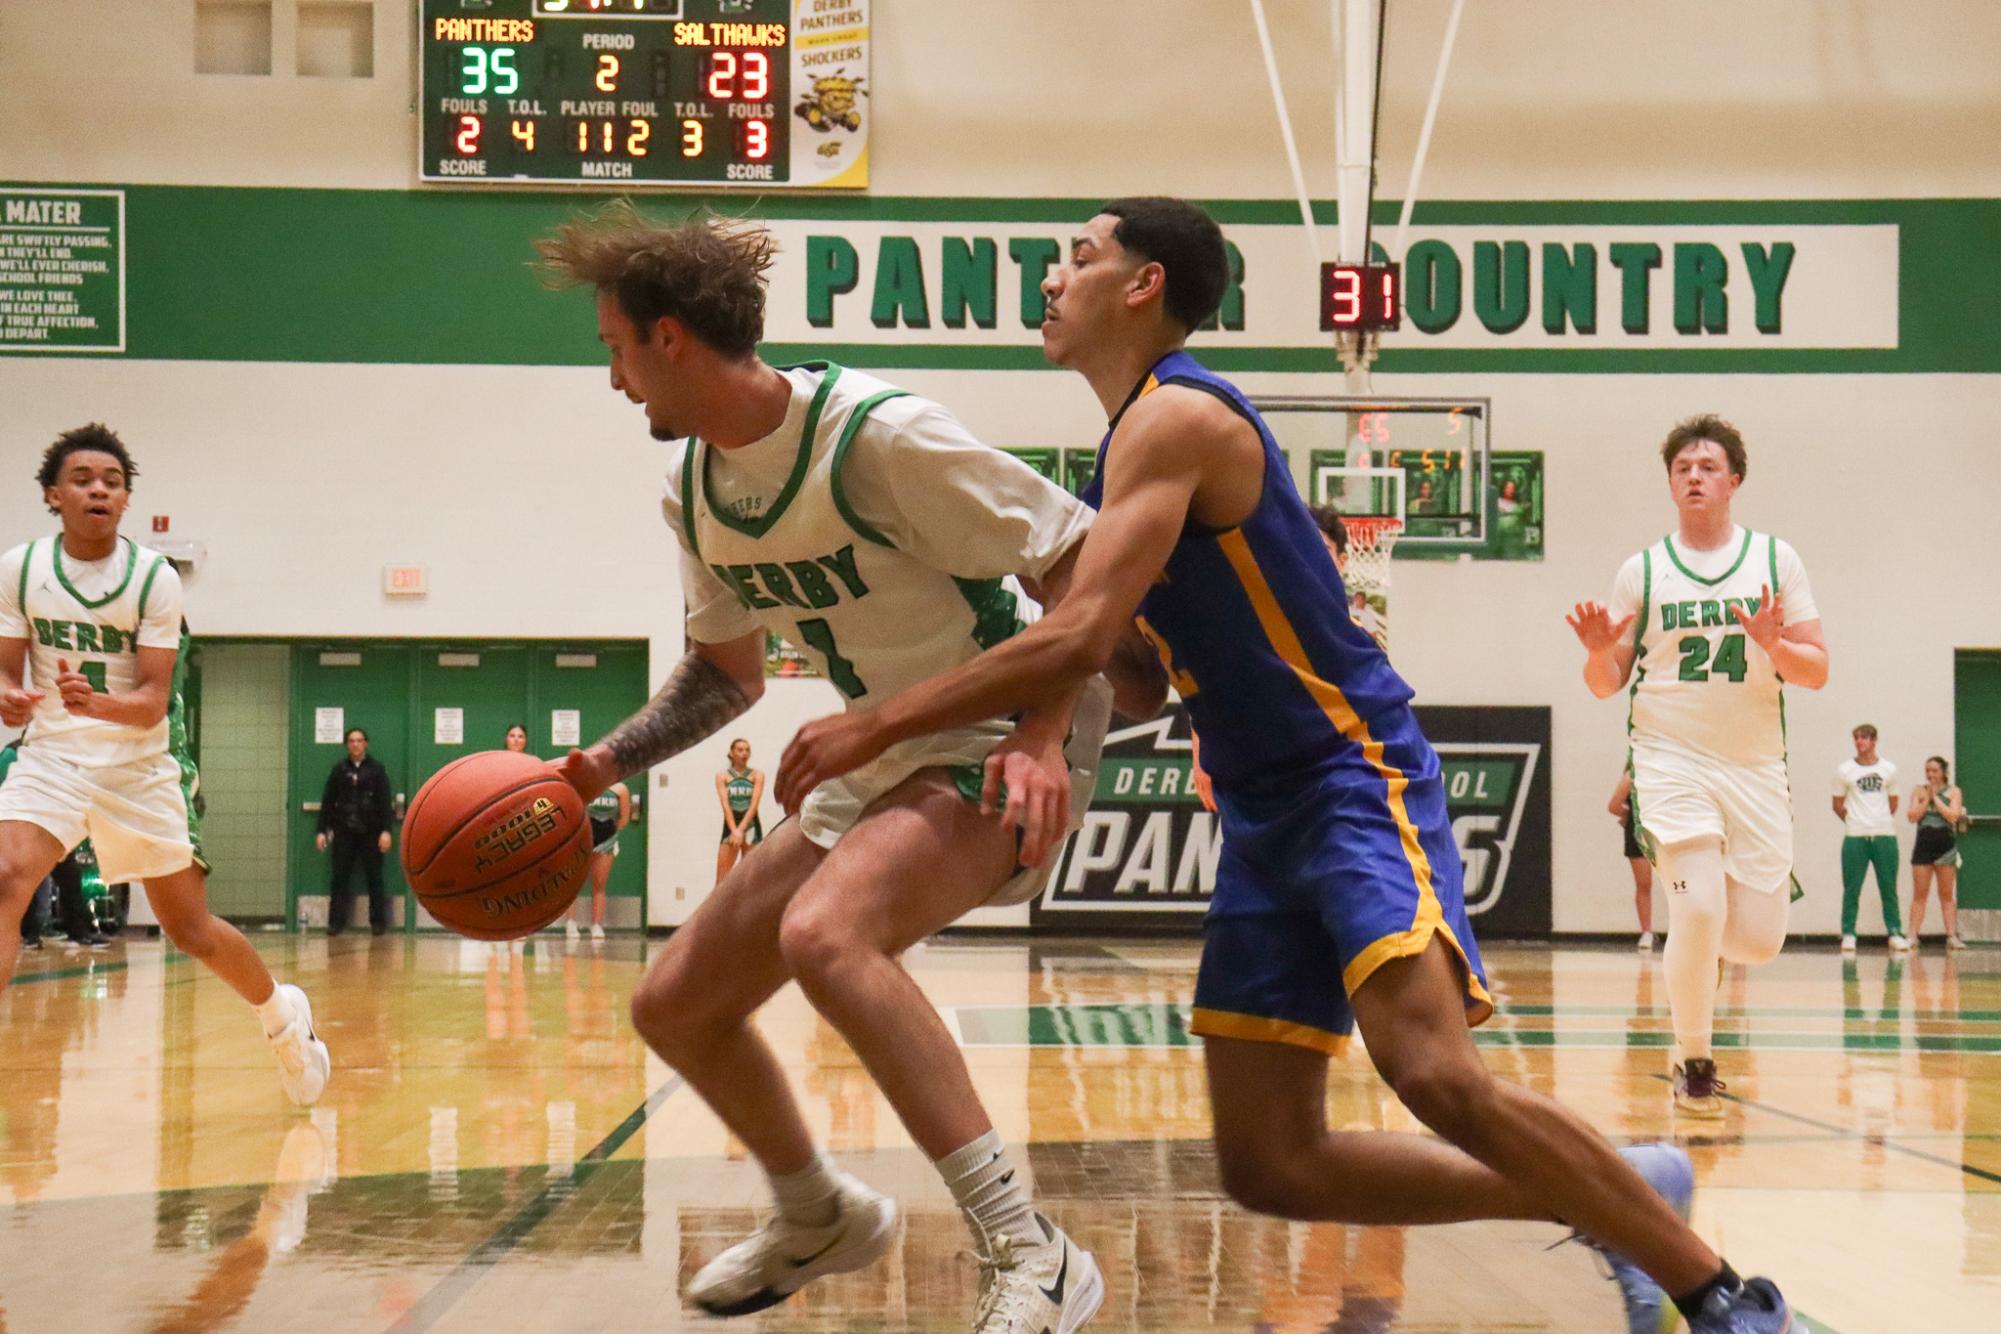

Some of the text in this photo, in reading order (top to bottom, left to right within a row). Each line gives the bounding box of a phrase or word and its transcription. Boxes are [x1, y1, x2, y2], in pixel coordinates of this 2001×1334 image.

[435, 18, 534, 43] PANTHERS
[801, 9, 864, 31] PANTHERS
[582, 33, 635, 50] PERIOD
[801, 46, 862, 67] SHOCKERS
[463, 47, 518, 94] 35
[596, 55, 619, 92] 2
[709, 52, 768, 99] 23
[441, 98, 488, 114] FOULS
[507, 99, 547, 116] T.O.L.
[560, 100, 659, 117] PLAYER FOUL
[674, 102, 714, 118] T.O.L.
[728, 103, 775, 119] FOULS
[458, 116, 481, 154] 2
[512, 120, 534, 152] 4
[627, 119, 650, 156] 2
[683, 119, 703, 157] 3
[747, 120, 768, 158] 3
[440, 159, 487, 175] SCORE
[581, 161, 633, 178] MATCH
[726, 163, 774, 180] SCORE
[6, 200, 81, 225] MATER
[17, 234, 61, 247] SWIFTLY
[32, 260, 60, 271] EVER
[38, 272, 83, 285] FRIENDS
[1368, 238, 1797, 335] OUNTRY
[17, 290, 44, 301] LOVE
[1333, 270, 1392, 322] 31
[14, 303, 42, 314] EACH
[44, 304, 79, 315] HEART
[7, 315, 34, 327] TRUE
[1678, 633, 1748, 683] 24
[473, 805, 567, 874] LEGACY
